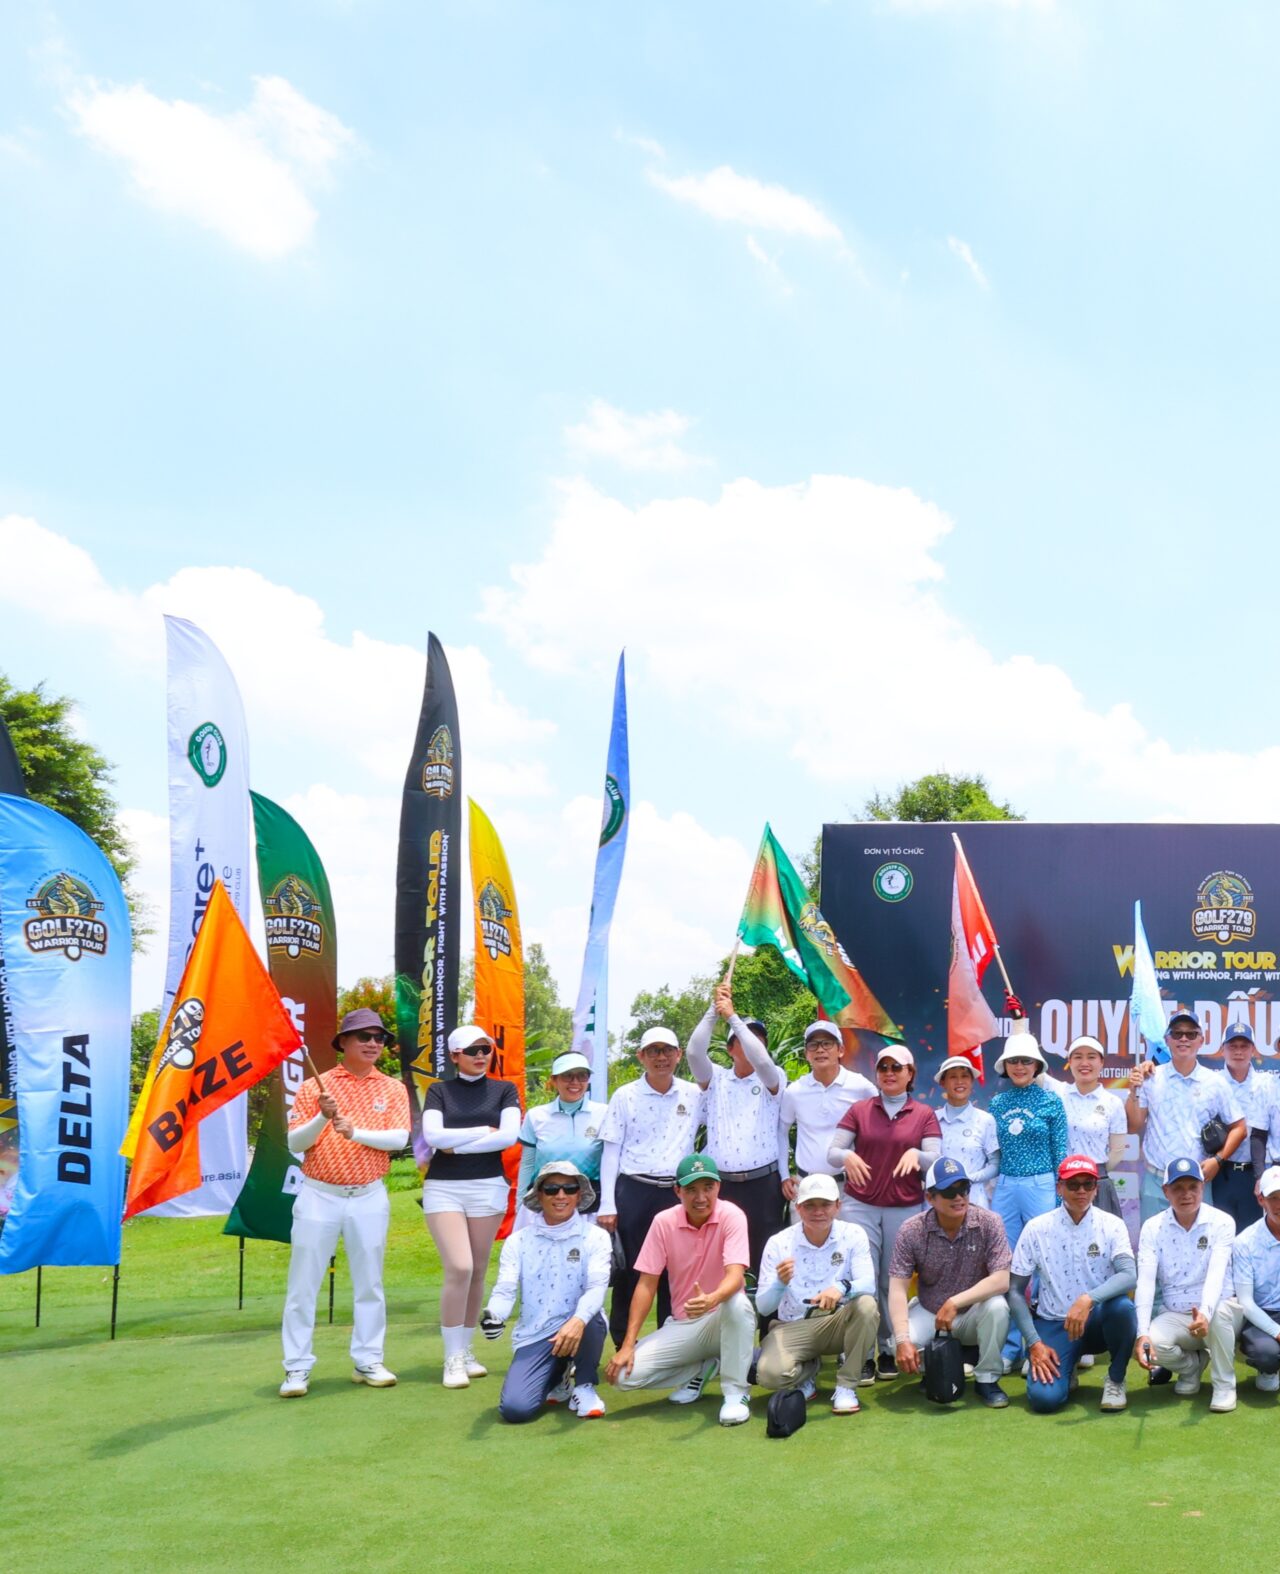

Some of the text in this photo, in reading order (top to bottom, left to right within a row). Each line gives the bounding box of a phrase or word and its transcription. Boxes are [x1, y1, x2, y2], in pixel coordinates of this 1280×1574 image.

[425, 830, 442, 928] TOUR
[439, 888, 447, 916] WITH
[28, 918, 104, 941] GOLF279
[266, 918, 321, 941] GOLF279
[1195, 909, 1253, 926] GOLF279
[1196, 924, 1251, 934] WARRIOR TOUR
[30, 937, 104, 951] WARRIOR TOUR
[302, 939, 320, 951] TOUR
[437, 920, 446, 953] FIGHT
[1112, 945, 1217, 978] WRRIOR
[1222, 951, 1277, 970] TOUR
[1172, 971, 1195, 980] WITH
[1197, 970, 1233, 981] HONOR,
[1235, 972, 1262, 980] FIGHT
[435, 955, 446, 1001] HONOR,
[436, 1004, 445, 1032] WITH
[1041, 989, 1178, 1058] QUY
[57, 1033, 92, 1185] DELTA
[147, 1040, 253, 1153] BZE
